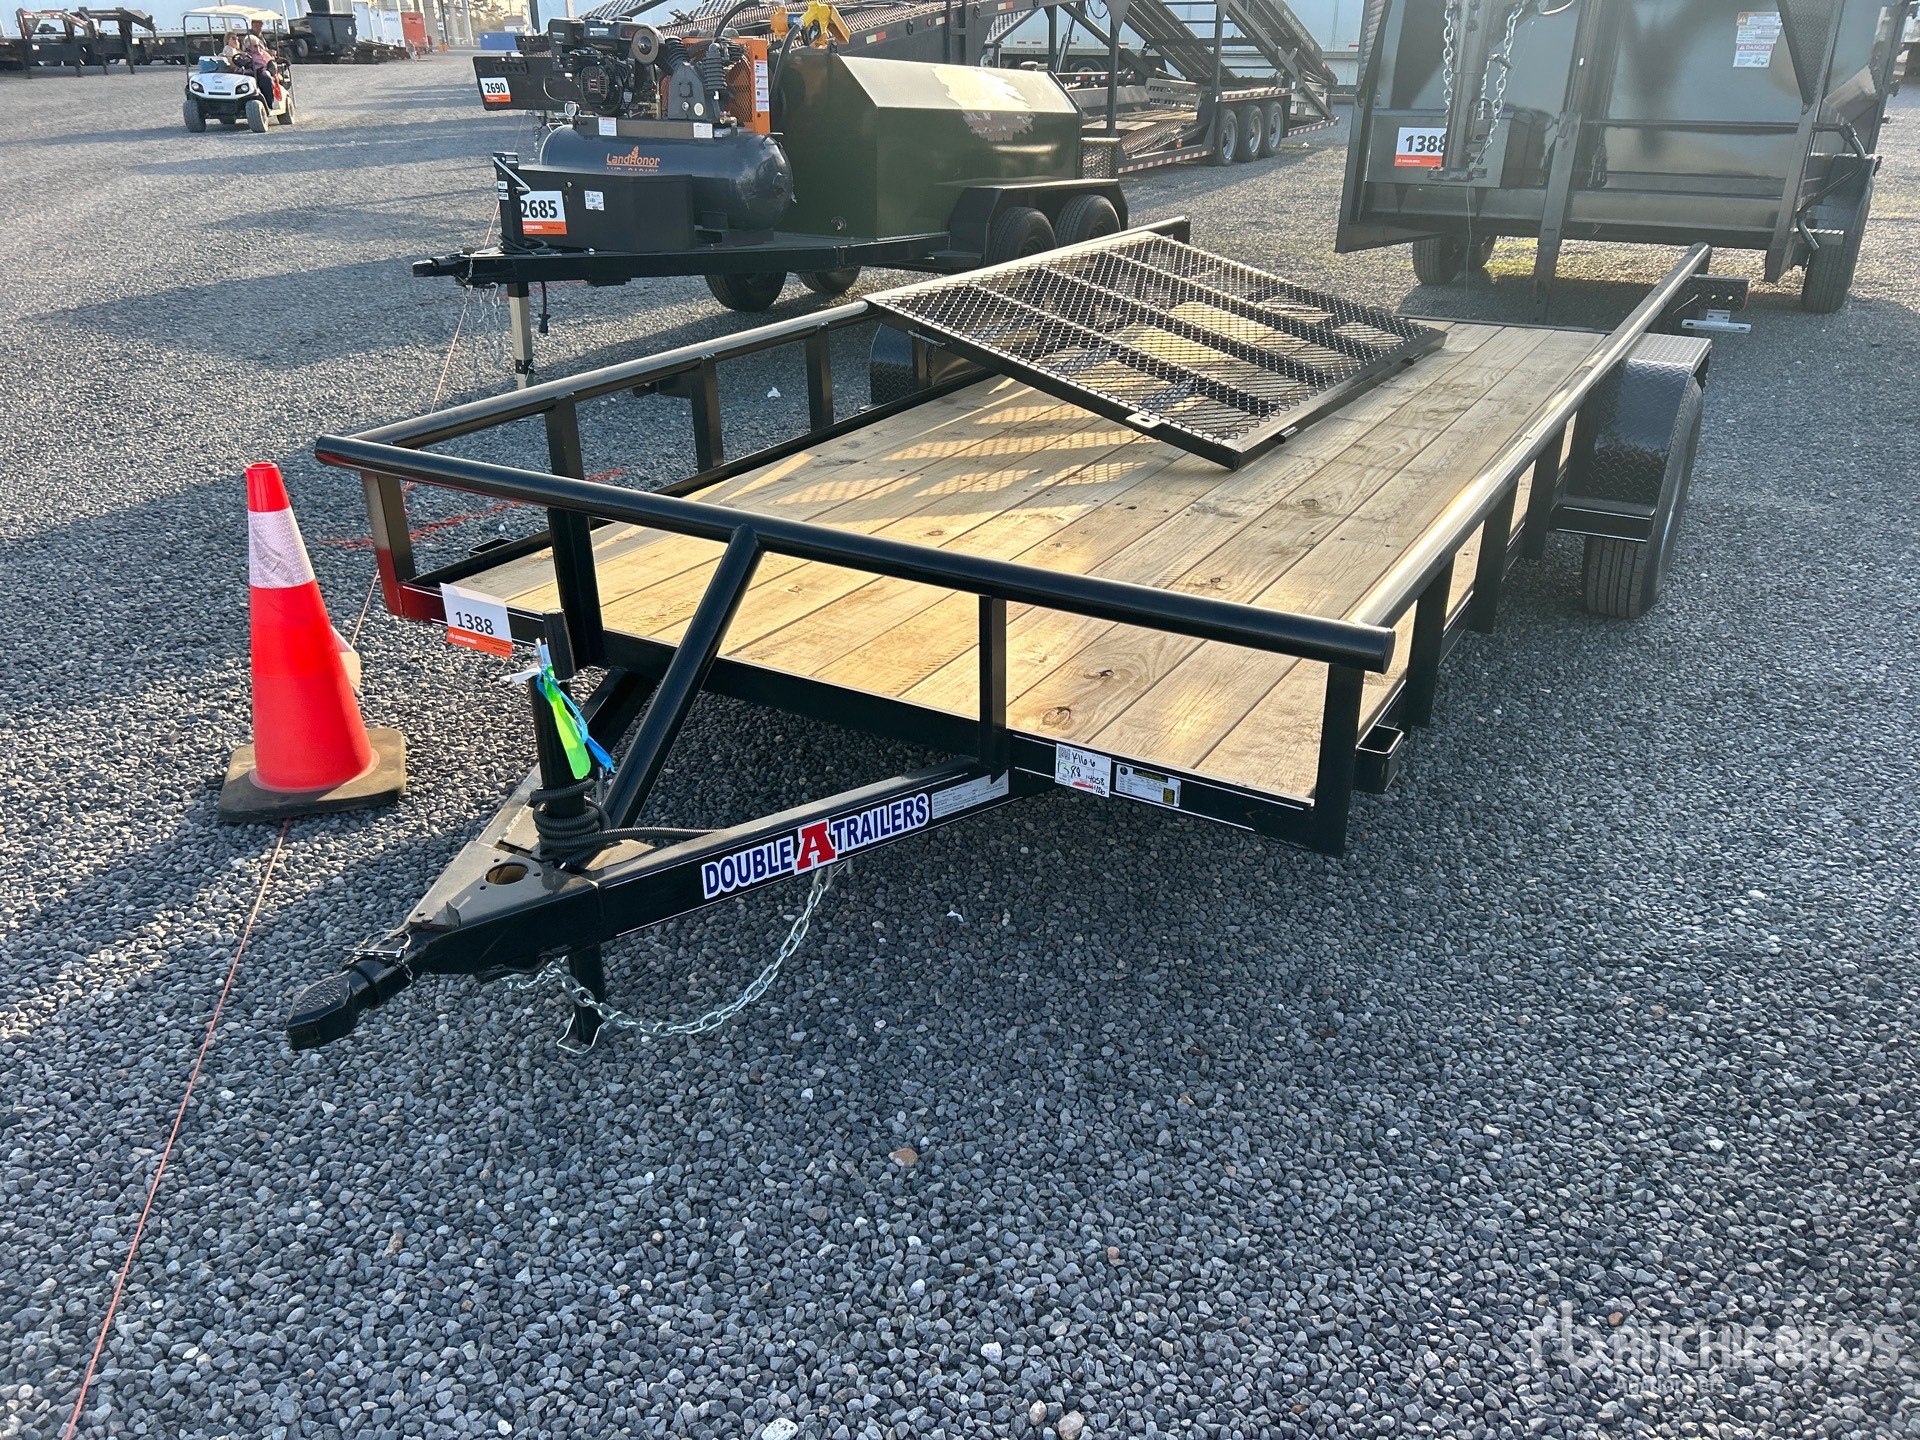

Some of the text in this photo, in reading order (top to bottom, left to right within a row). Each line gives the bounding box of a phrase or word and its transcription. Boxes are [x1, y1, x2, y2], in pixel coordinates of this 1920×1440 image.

[485, 82, 506, 94] 2690
[1405, 134, 1446, 153] 1388
[606, 152, 661, 168] LandHonor
[521, 199, 558, 219] 2685
[455, 611, 495, 636] 1388
[703, 838, 794, 897] DOUBLE
[796, 821, 837, 871] A
[832, 794, 928, 851] TRAILERS
